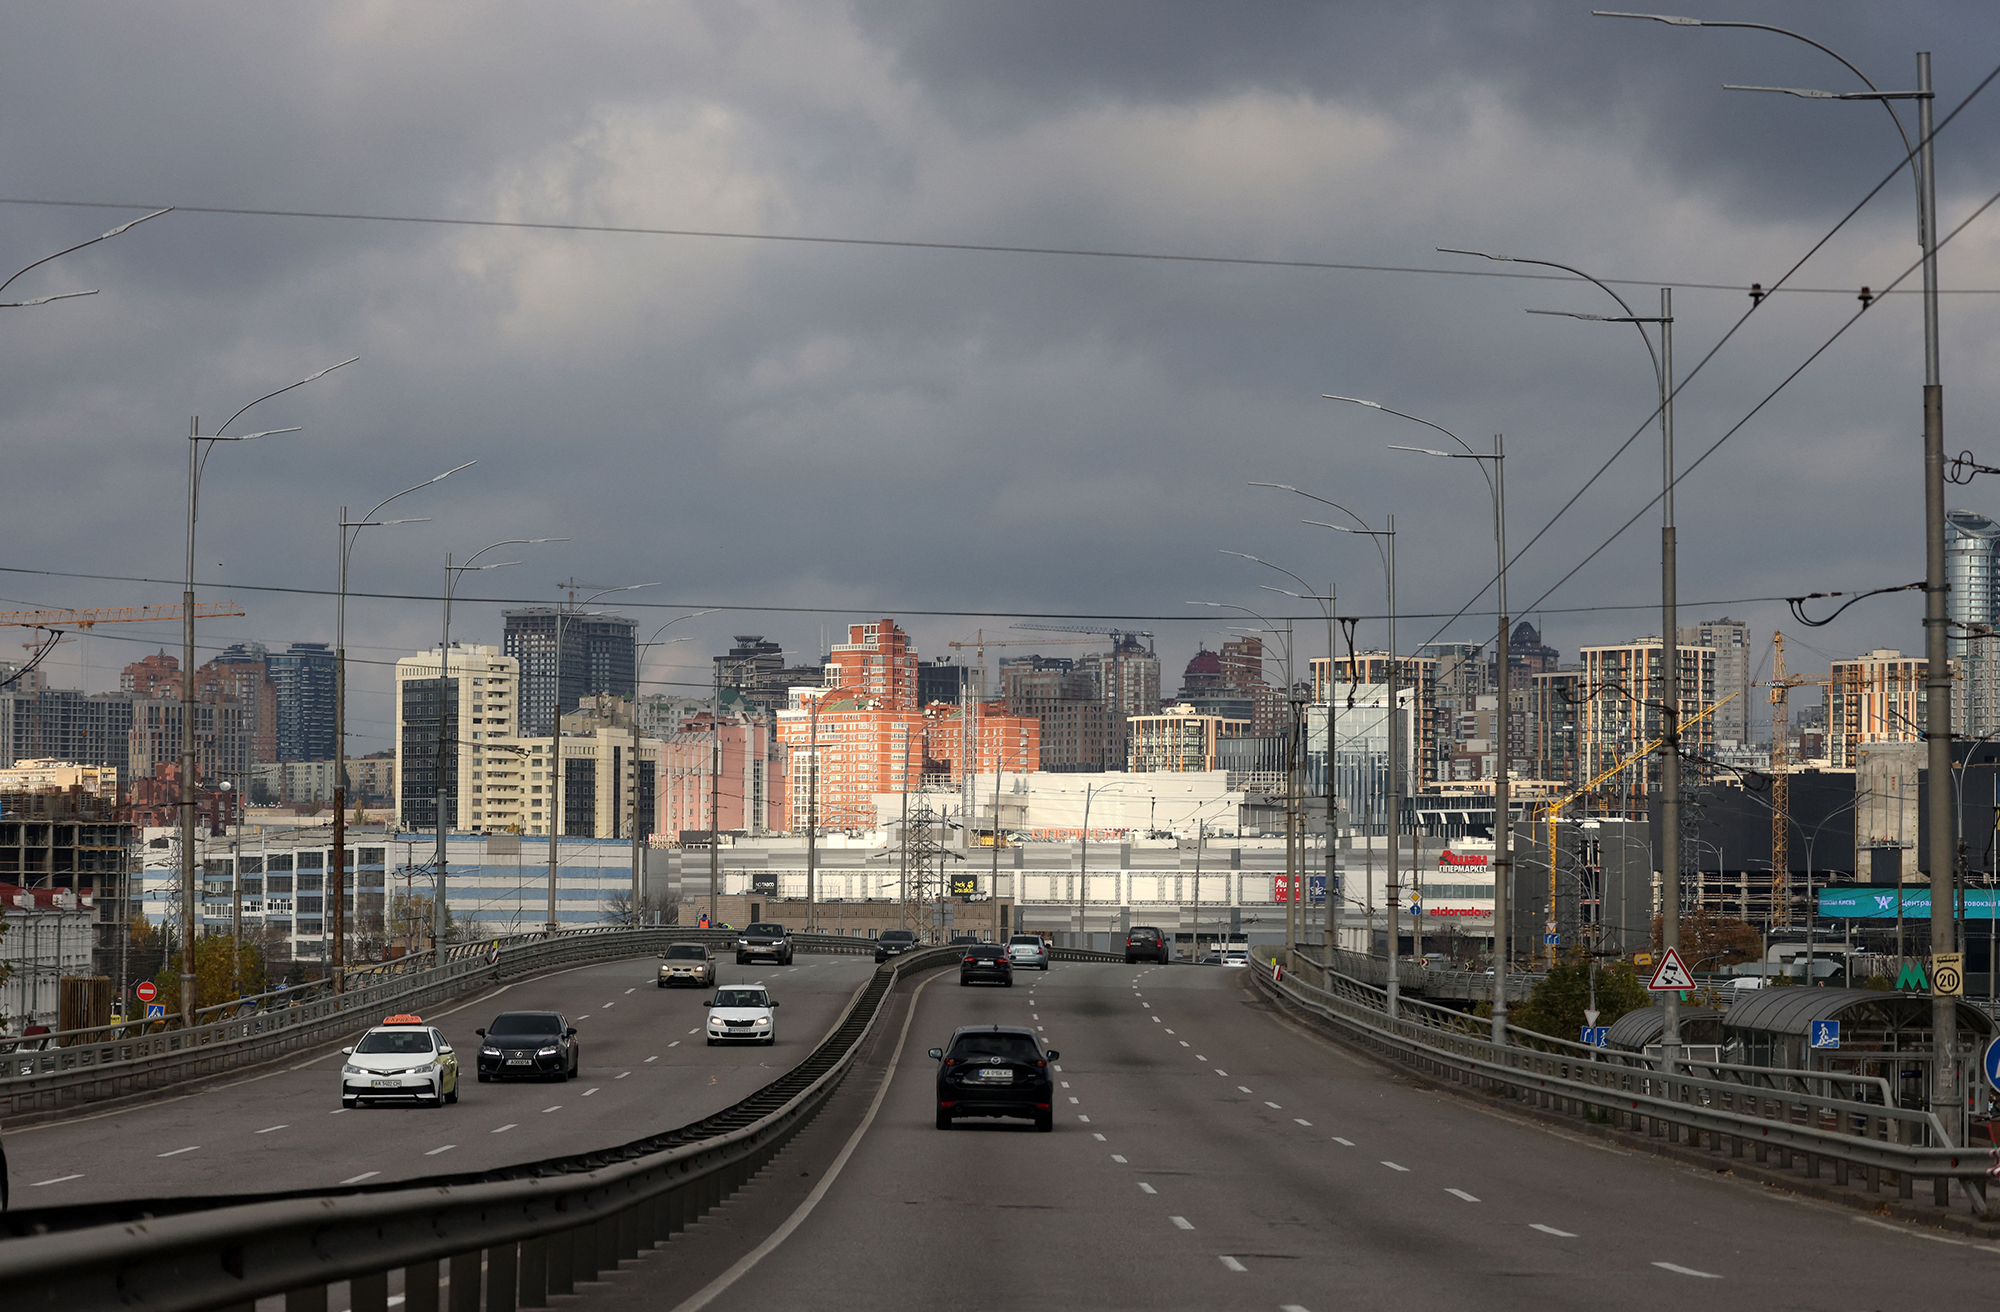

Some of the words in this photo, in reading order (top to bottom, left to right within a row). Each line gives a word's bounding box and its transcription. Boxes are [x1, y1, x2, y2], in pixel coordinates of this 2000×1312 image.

[1439, 850, 1487, 865] Ашан
[1439, 865, 1487, 873] ГІПЕРМАРКЕТ
[1939, 973, 1956, 987] 20
